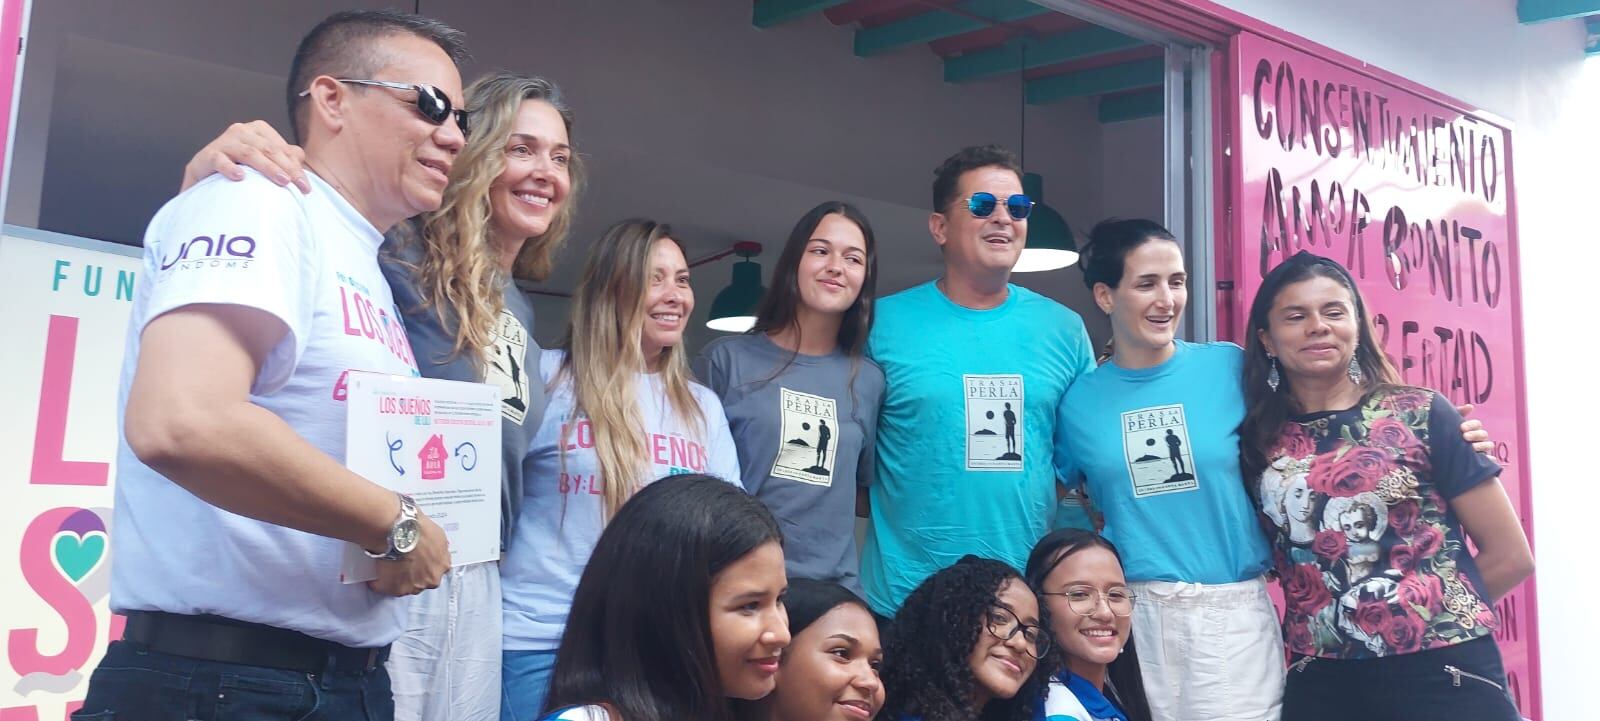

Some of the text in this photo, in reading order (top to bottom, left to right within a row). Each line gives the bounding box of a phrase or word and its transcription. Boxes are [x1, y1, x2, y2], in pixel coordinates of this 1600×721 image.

[1260, 167, 1501, 309] AMOR BONITO
[52, 259, 134, 302] FUN
[339, 286, 385, 345] LOS
[969, 386, 1018, 398] PERLA
[379, 396, 397, 414] LOS
[398, 395, 432, 416] SUEÑOS
[786, 399, 833, 418] PERLA
[1128, 416, 1180, 431] PERLA
